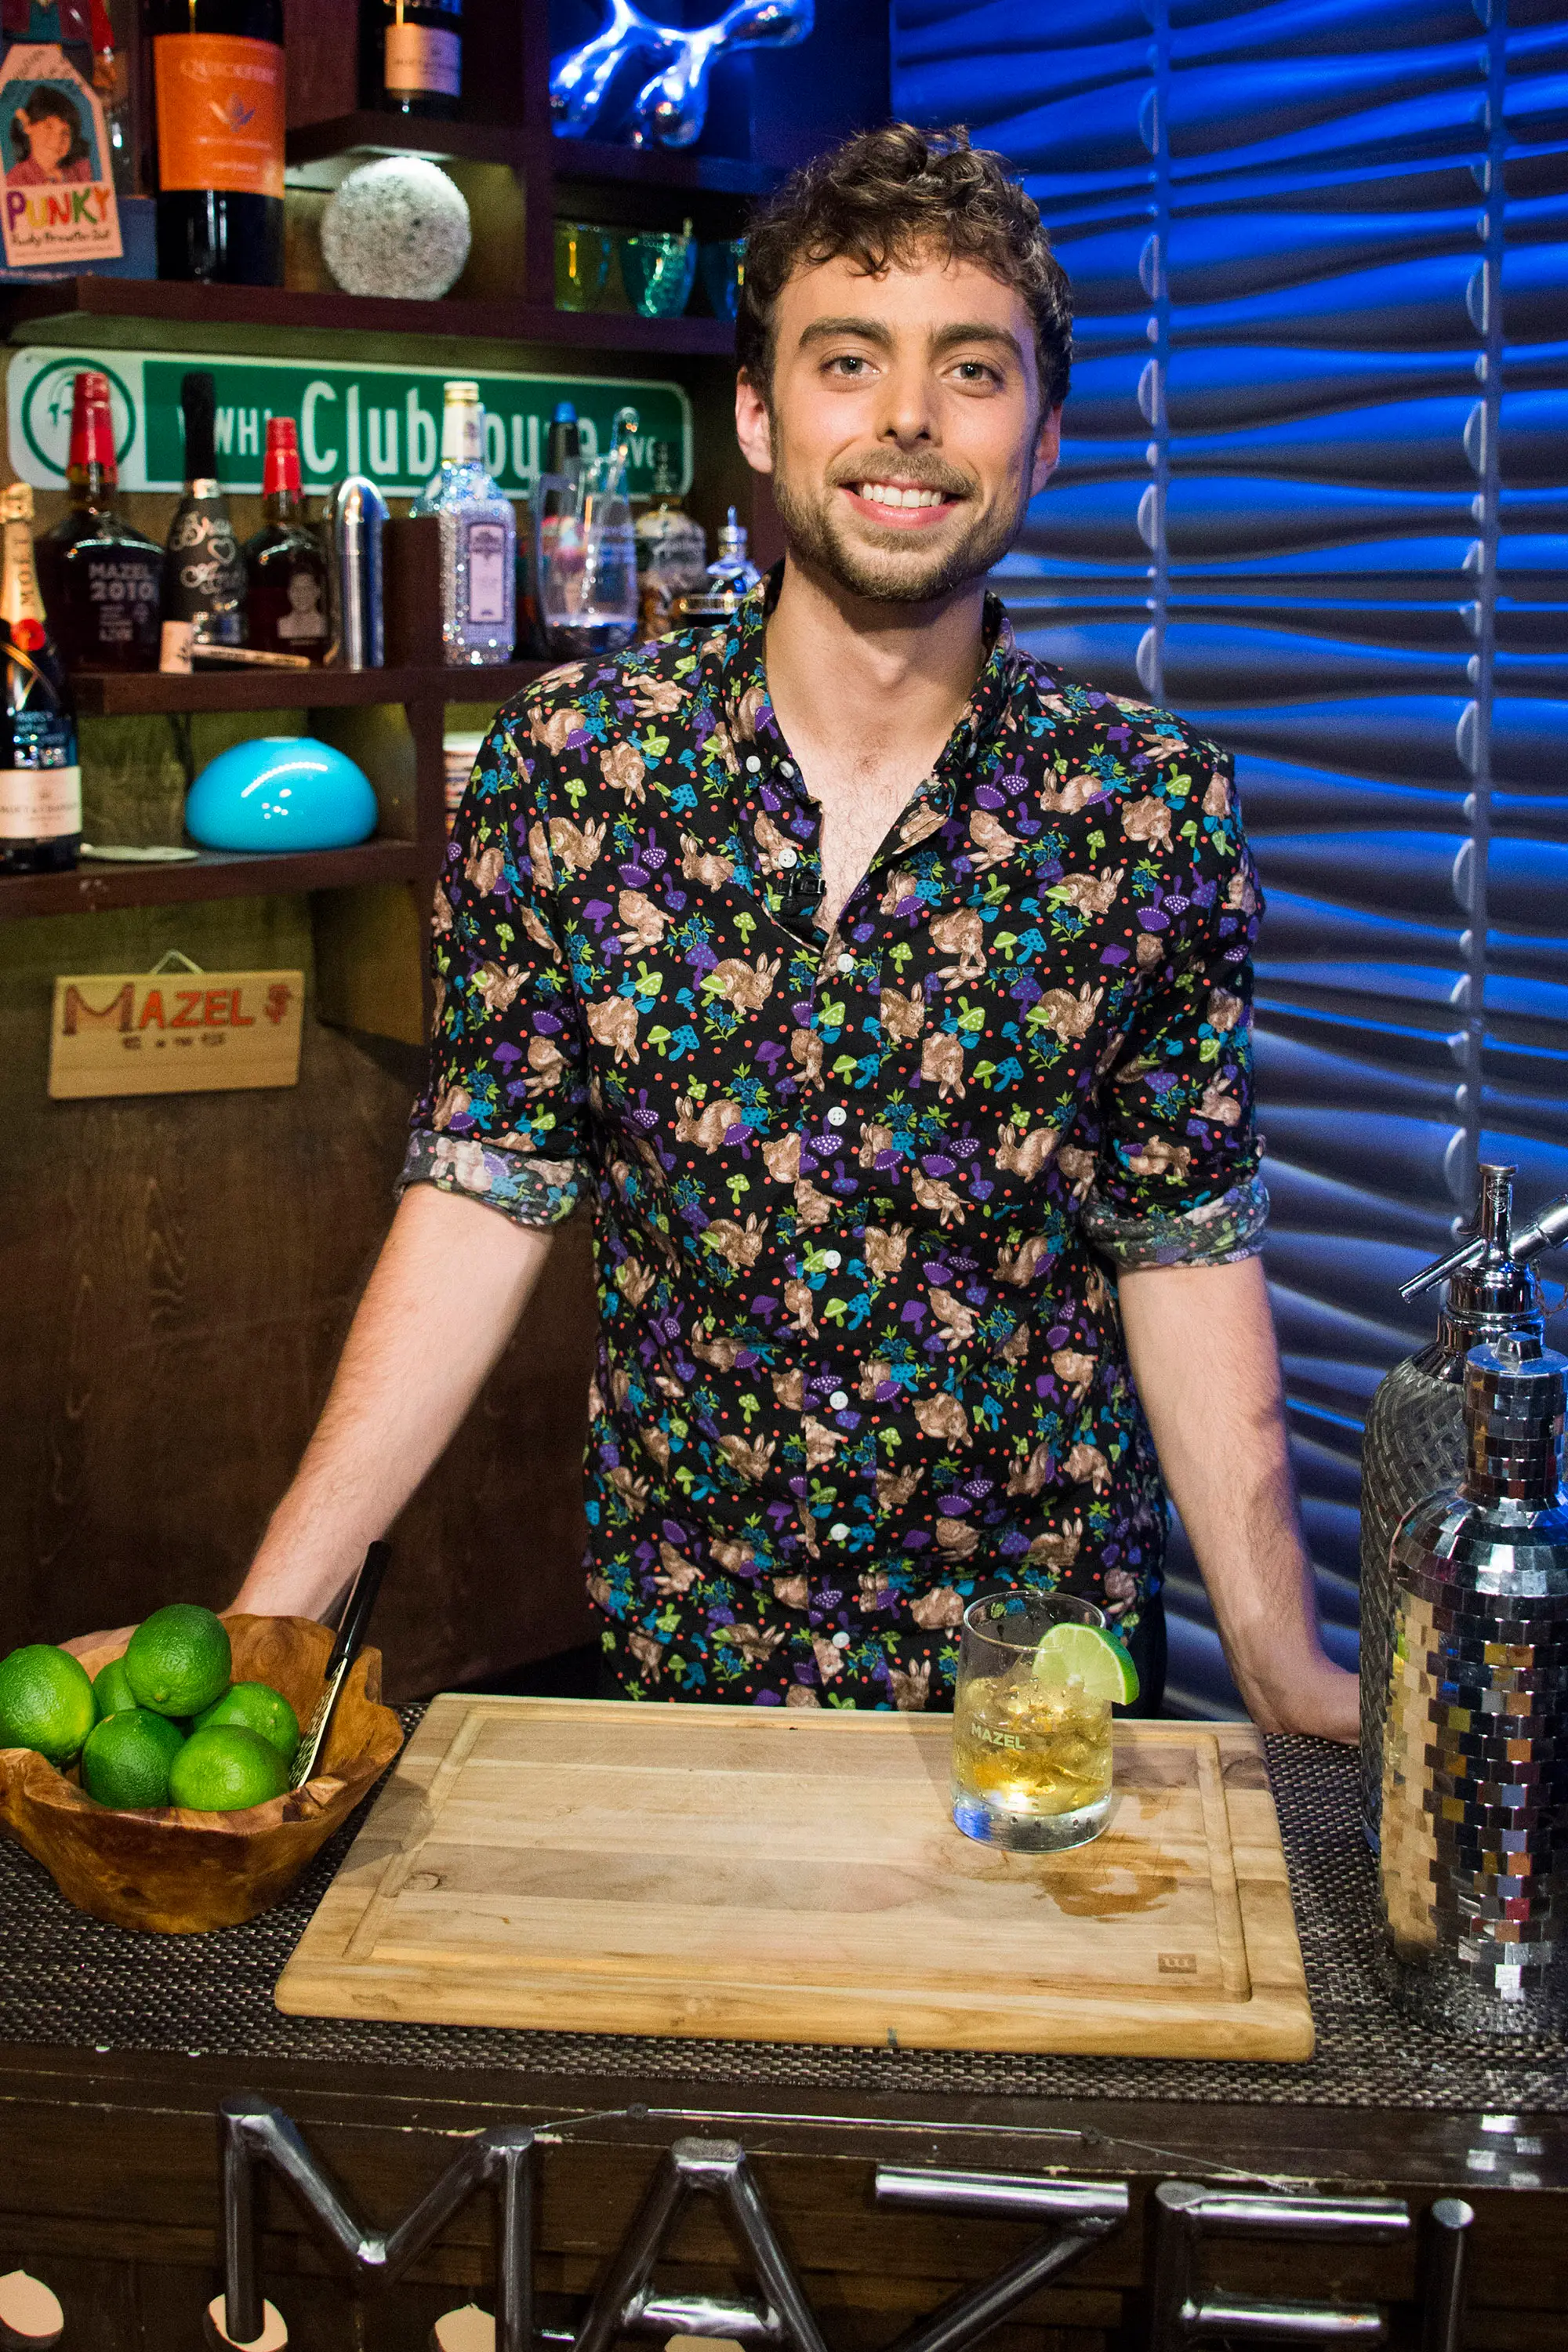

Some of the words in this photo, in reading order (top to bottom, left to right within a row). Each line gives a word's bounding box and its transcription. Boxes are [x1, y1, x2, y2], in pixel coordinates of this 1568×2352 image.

[6, 187, 111, 231] PUNKY
[177, 405, 273, 456] WH
[301, 381, 598, 478] Cluboue
[89, 581, 157, 601] 2010
[63, 982, 256, 1036] MAZEL
[971, 1722, 1026, 1751] MAZEL
